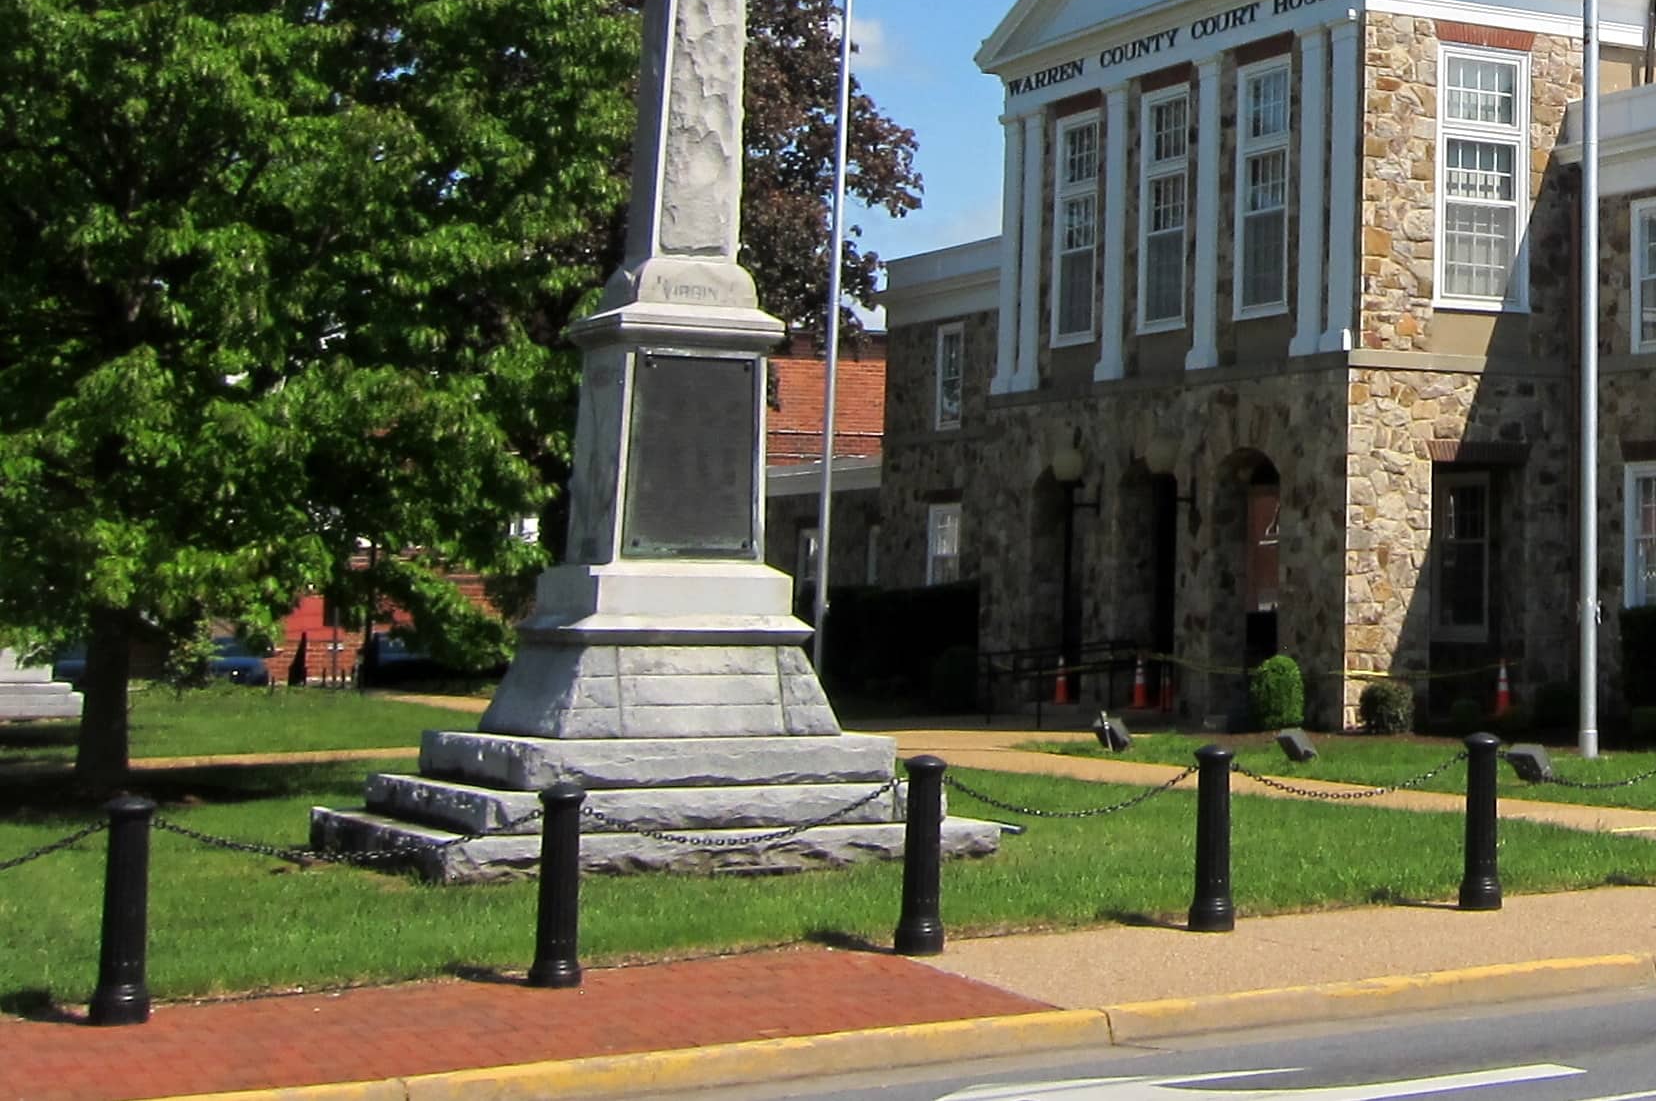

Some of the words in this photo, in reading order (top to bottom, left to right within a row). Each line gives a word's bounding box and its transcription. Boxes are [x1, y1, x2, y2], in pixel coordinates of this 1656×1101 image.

[1007, 58, 1086, 97] WARREN
[1100, 27, 1180, 69] COUNTY
[1191, 2, 1261, 40] COURT
